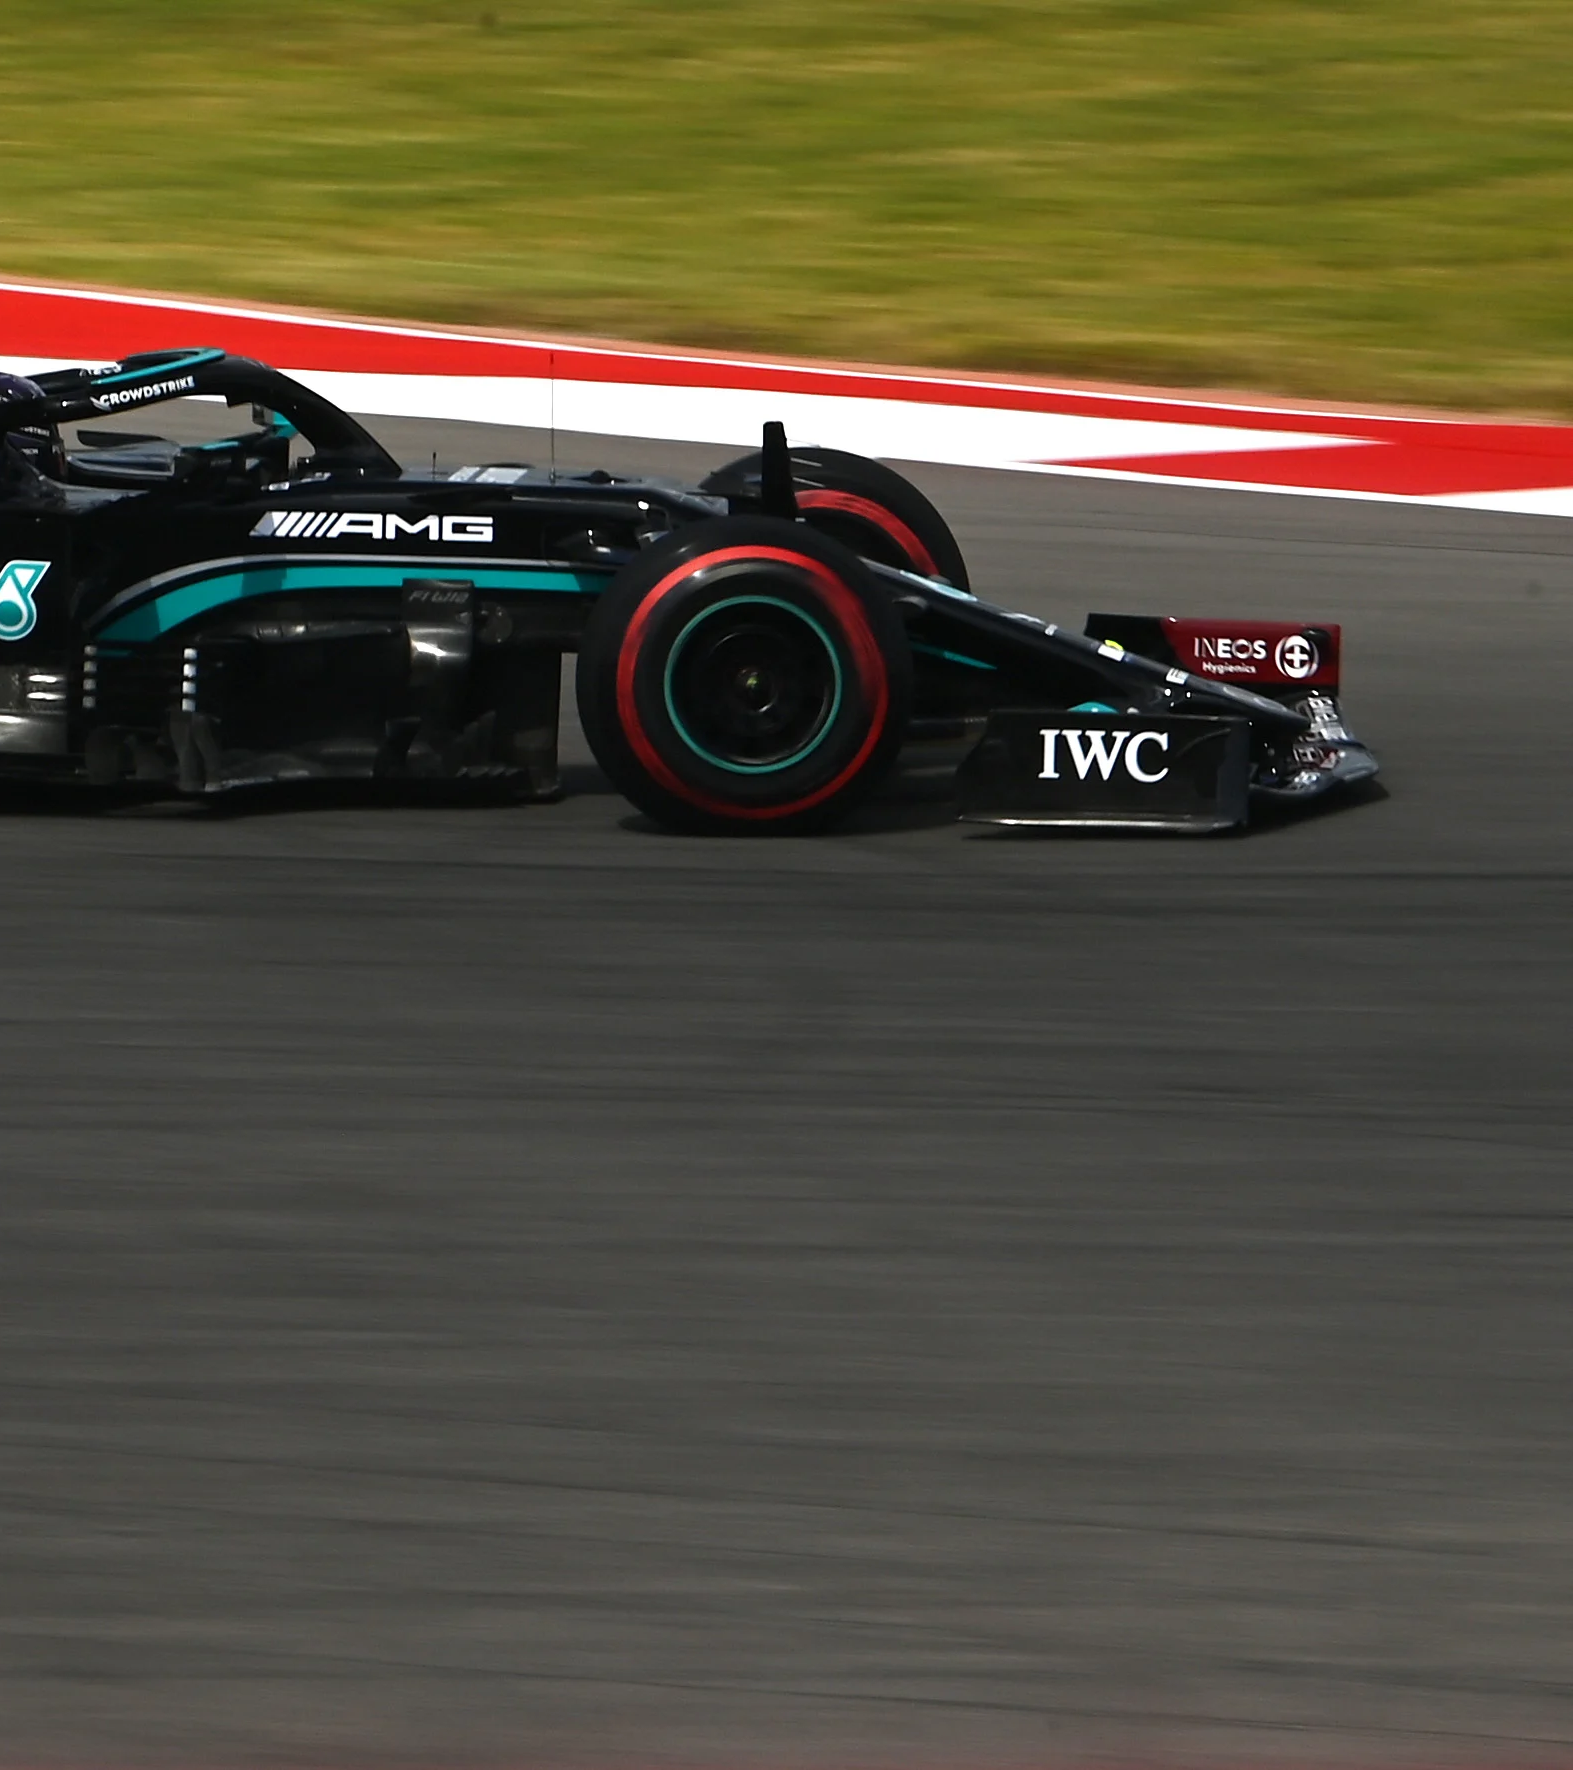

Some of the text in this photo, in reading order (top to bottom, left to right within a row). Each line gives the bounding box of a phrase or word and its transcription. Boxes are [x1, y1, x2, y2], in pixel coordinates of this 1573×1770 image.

[99, 375, 196, 406] CROWDSTRIKE
[327, 513, 494, 542] AMG
[1194, 637, 1267, 660] INEOS
[1202, 661, 1257, 675] Hygienics
[1038, 728, 1169, 782] IWC
